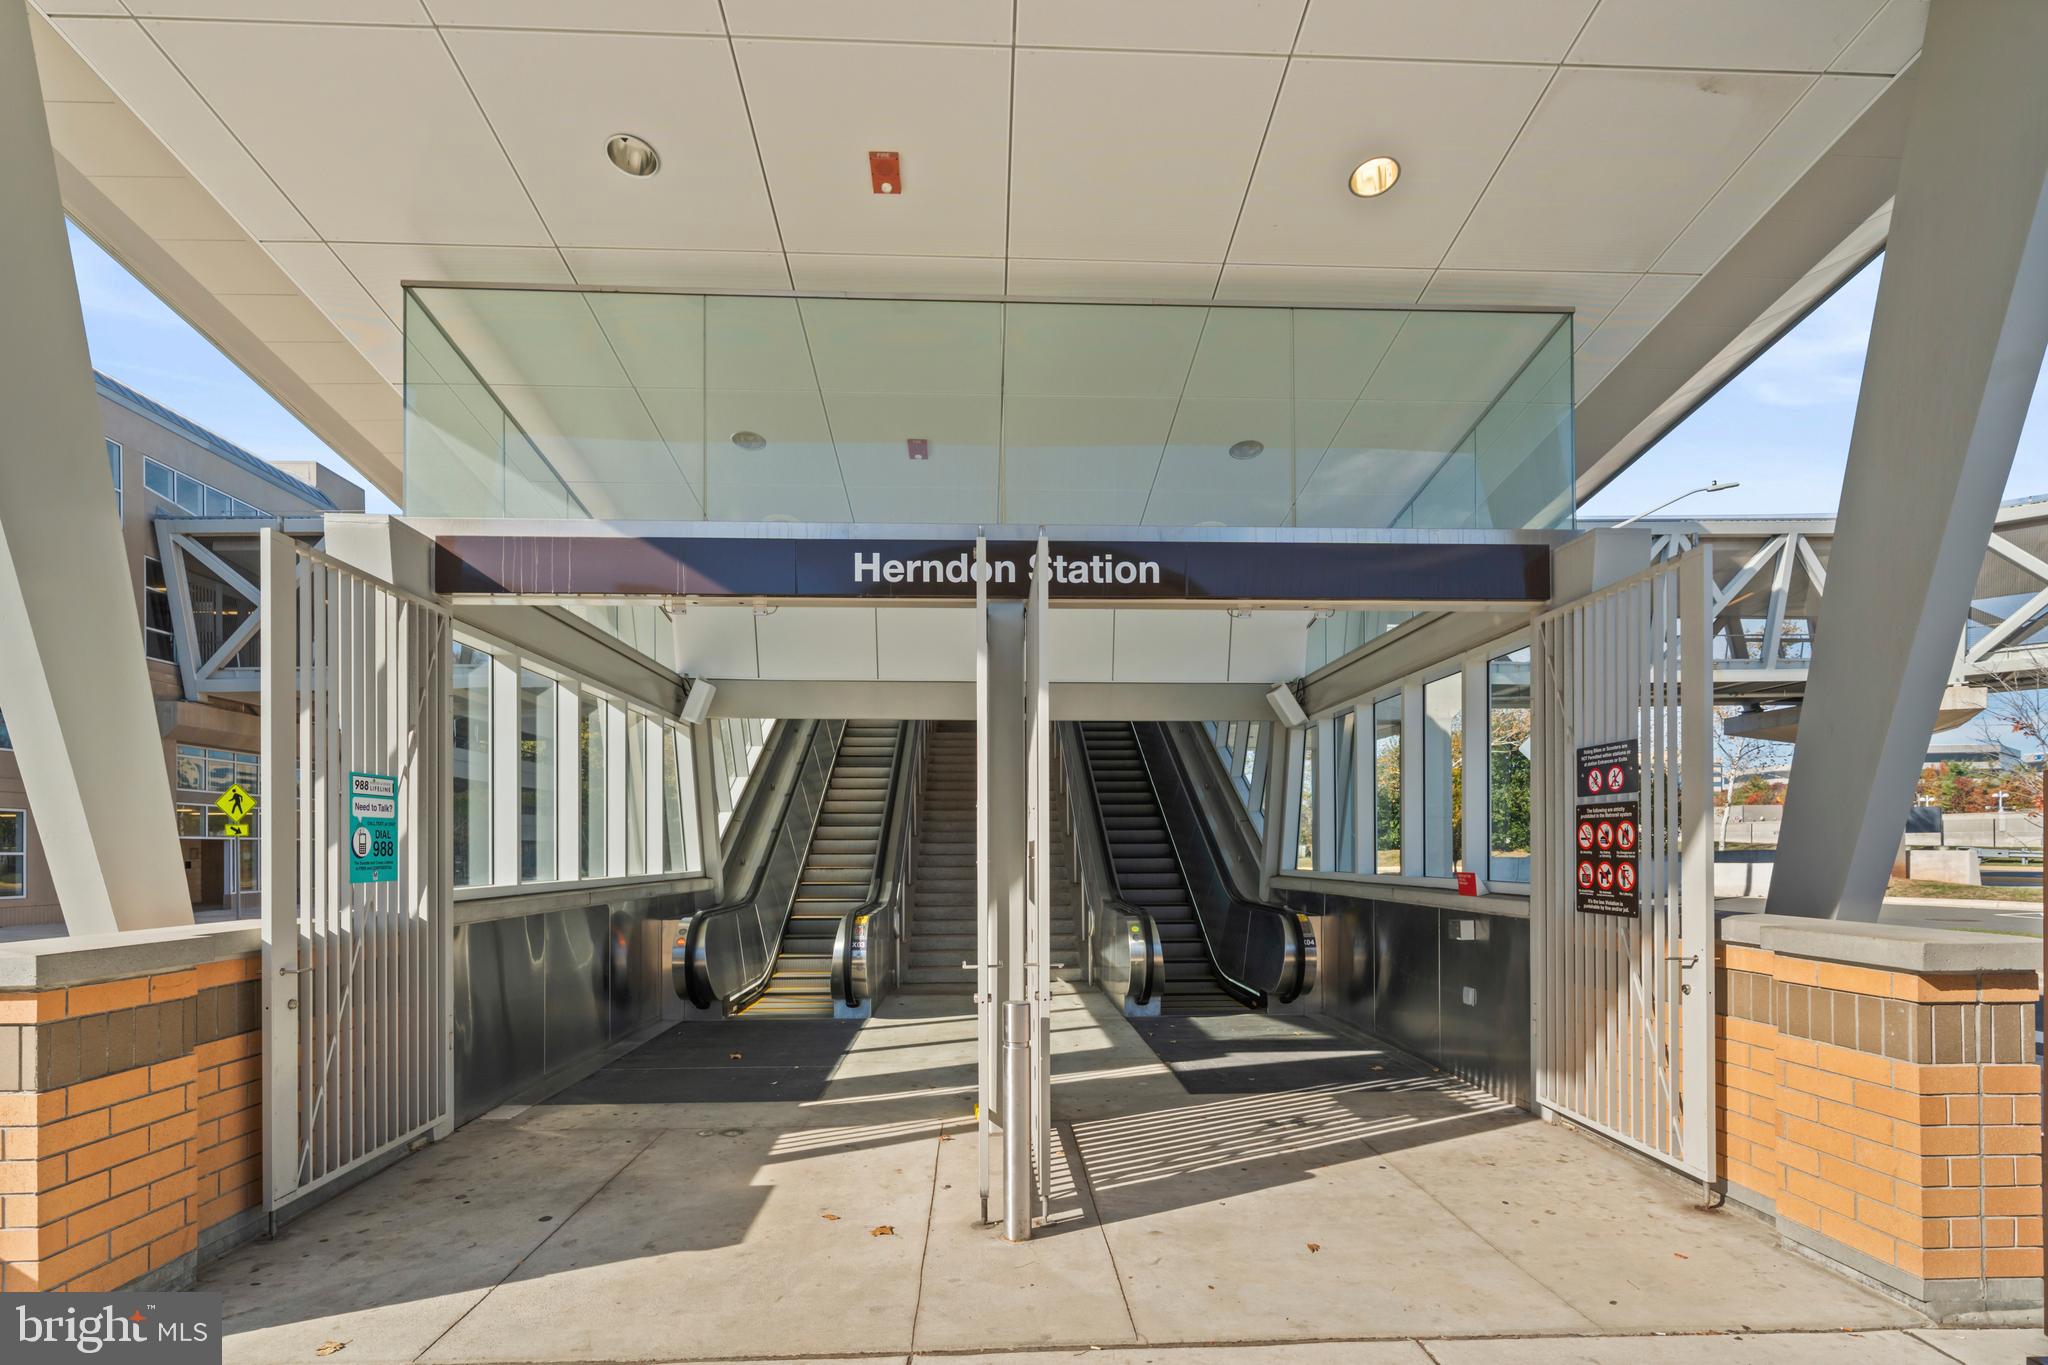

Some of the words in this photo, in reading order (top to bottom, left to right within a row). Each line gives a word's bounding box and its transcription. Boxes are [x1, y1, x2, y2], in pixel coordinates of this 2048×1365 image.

[854, 552, 1016, 583] Herndon
[355, 780, 368, 790] 988
[355, 803, 370, 811] Need
[378, 804, 392, 812] Talk?
[376, 830, 391, 839] DIAL
[373, 841, 393, 856] 988
